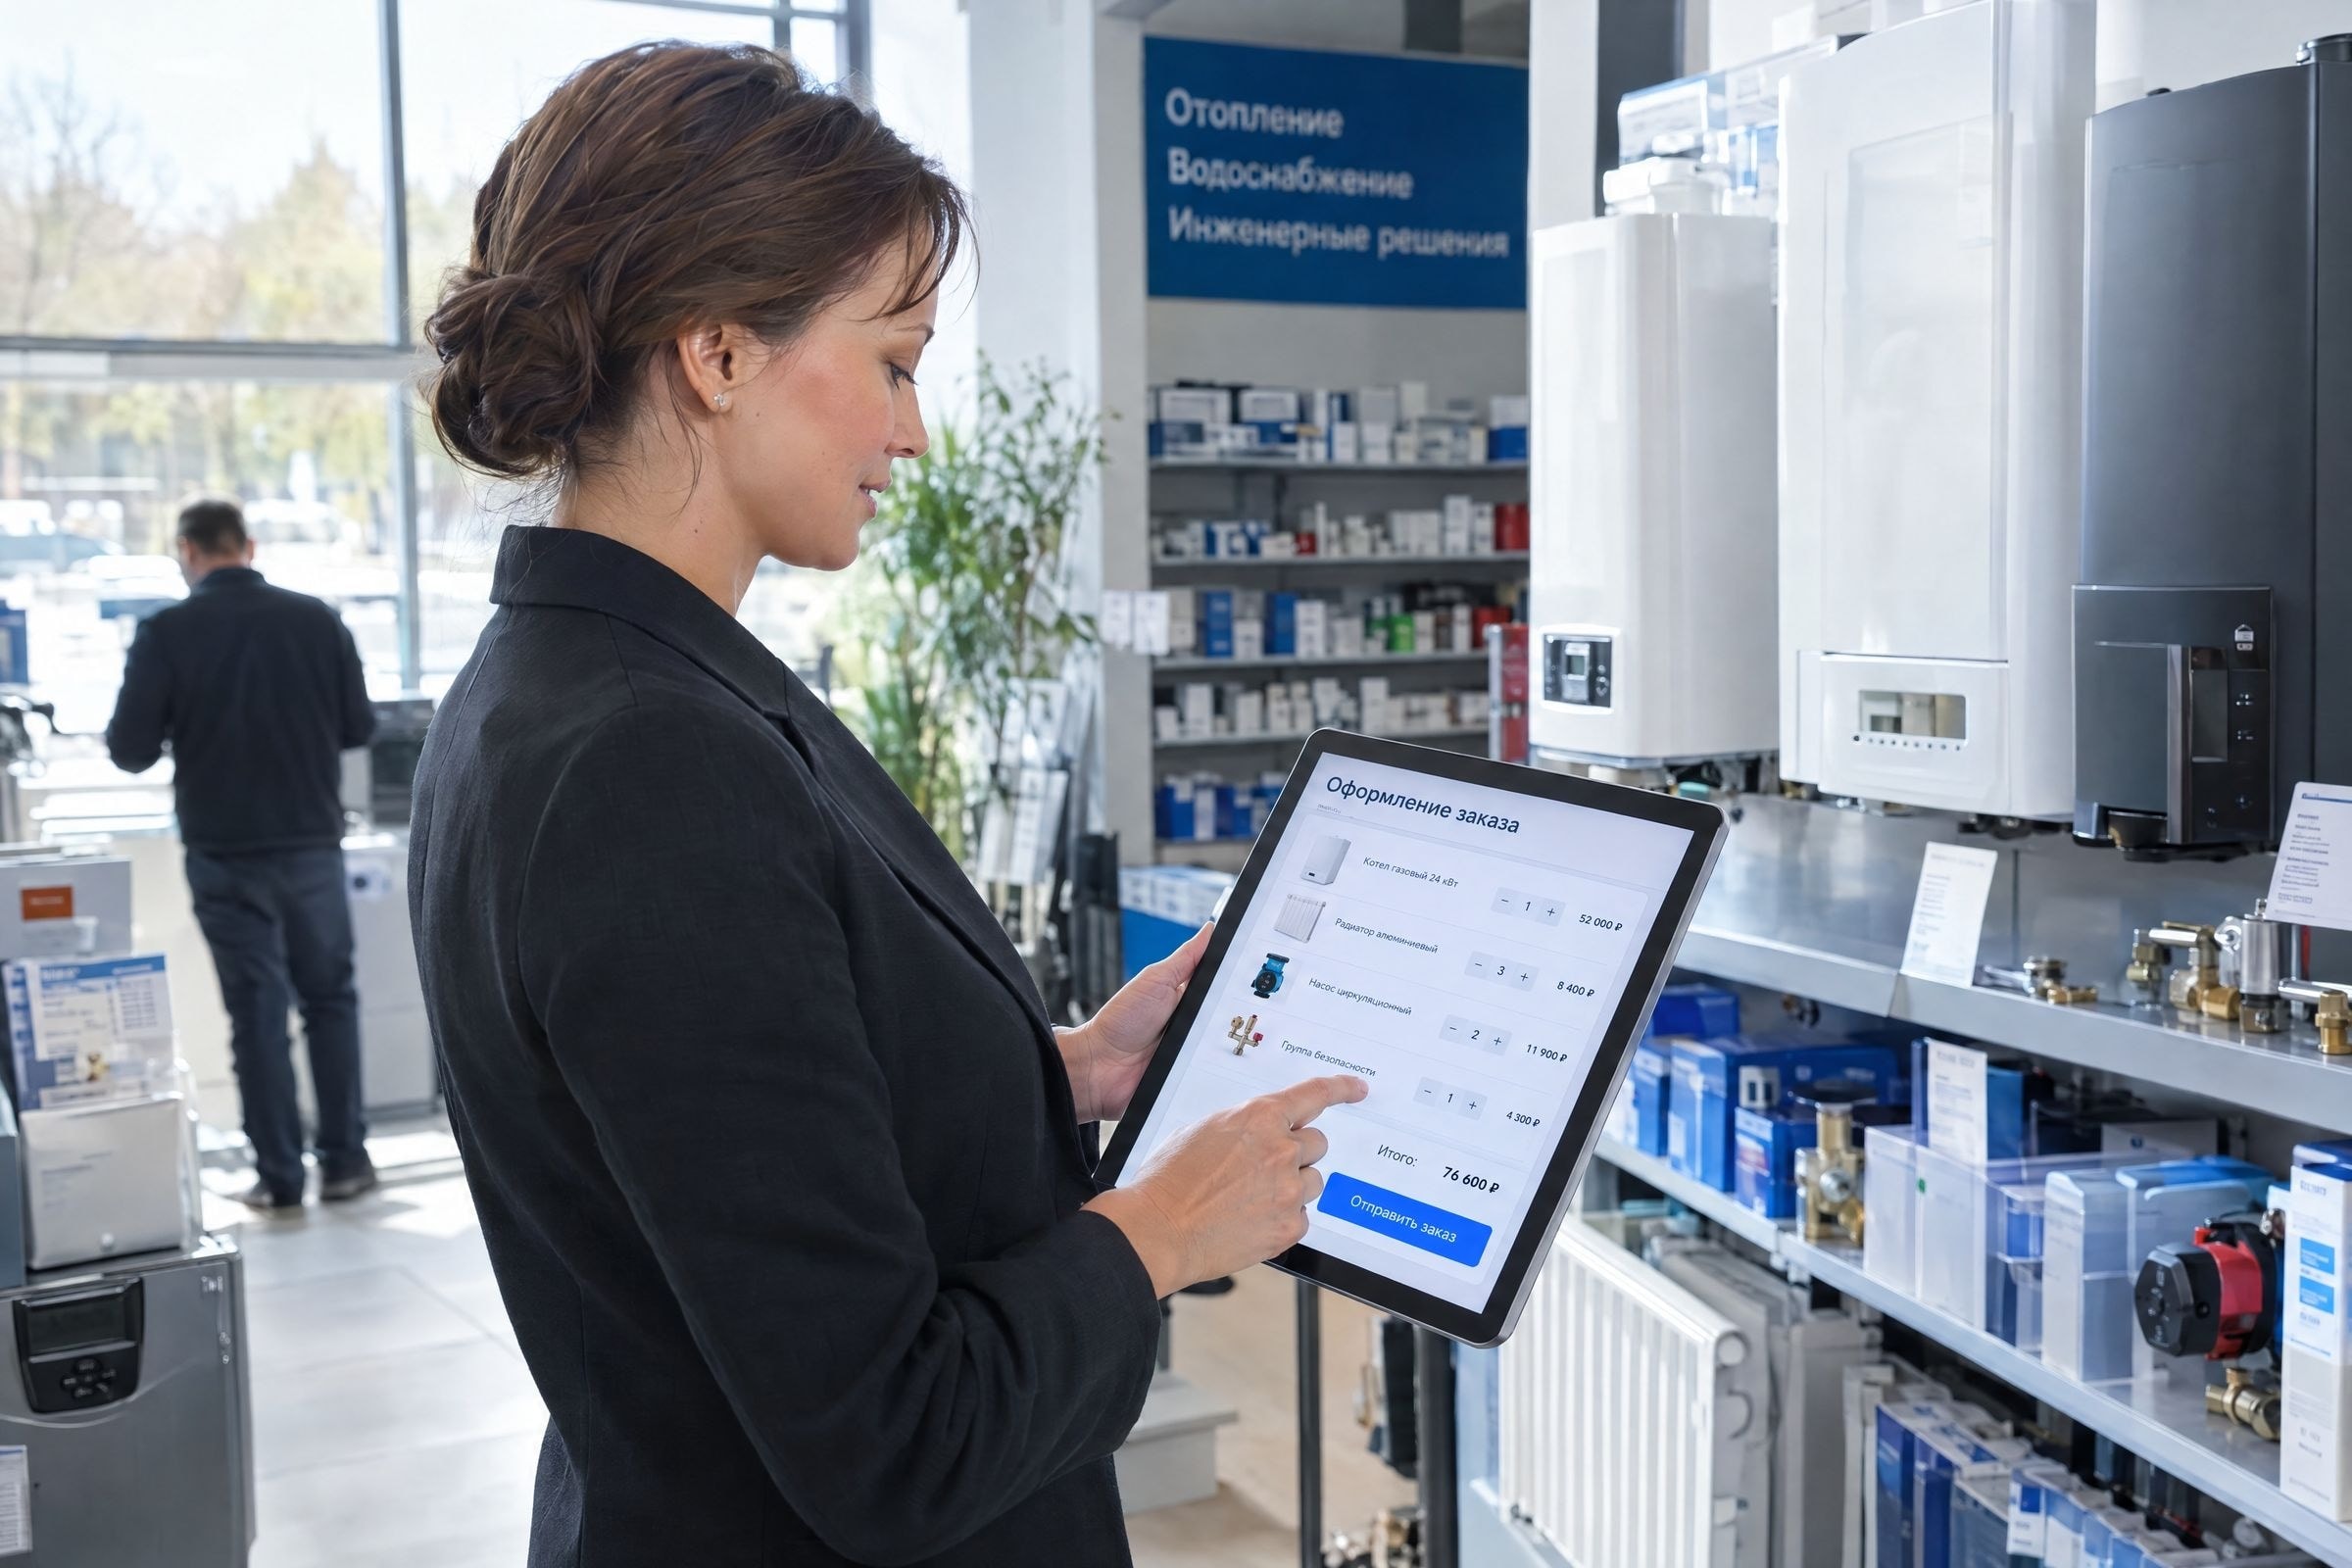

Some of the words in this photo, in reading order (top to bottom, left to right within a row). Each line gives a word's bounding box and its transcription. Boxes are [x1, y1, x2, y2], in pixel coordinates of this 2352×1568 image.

[1165, 87, 1344, 137] Отопление
[1167, 146, 1413, 198] Водоснабжение
[1168, 207, 1370, 256] Инженерные
[1377, 226, 1508, 259] решения
[1326, 776, 1452, 818] Оформление
[1455, 806, 1520, 834] заказа
[1363, 857, 1390, 871] Котел
[1391, 864, 1428, 880] газовый
[1429, 873, 1442, 883] 24
[1442, 877, 1459, 888] кВт
[1525, 901, 1531, 911] 1
[1579, 913, 1592, 925] 52
[1593, 917, 1613, 930] 000
[1335, 917, 1375, 937] Радиатор
[1376, 931, 1438, 954] алюминиевый
[1497, 965, 1505, 976] 3
[1308, 978, 1336, 993] Насос
[1337, 988, 1411, 1015] циркуляционный
[1556, 981, 1564, 991] 8
[1566, 984, 1586, 996] 400
[1471, 1029, 1480, 1040] 2
[1281, 1040, 1313, 1057] Группа
[1314, 1051, 1376, 1077] безопасности
[1527, 1044, 1538, 1054] 11
[1540, 1048, 1558, 1060] 900
[1447, 1093, 1453, 1103] 1
[1506, 1111, 1513, 1120] 4
[1514, 1113, 1533, 1125] 300
[1377, 1144, 1418, 1167] Итого:
[1443, 1166, 1459, 1182] 76
[1462, 1174, 1488, 1191] 600
[1350, 1195, 1418, 1230] Отправить
[1420, 1223, 1457, 1243] заказ
